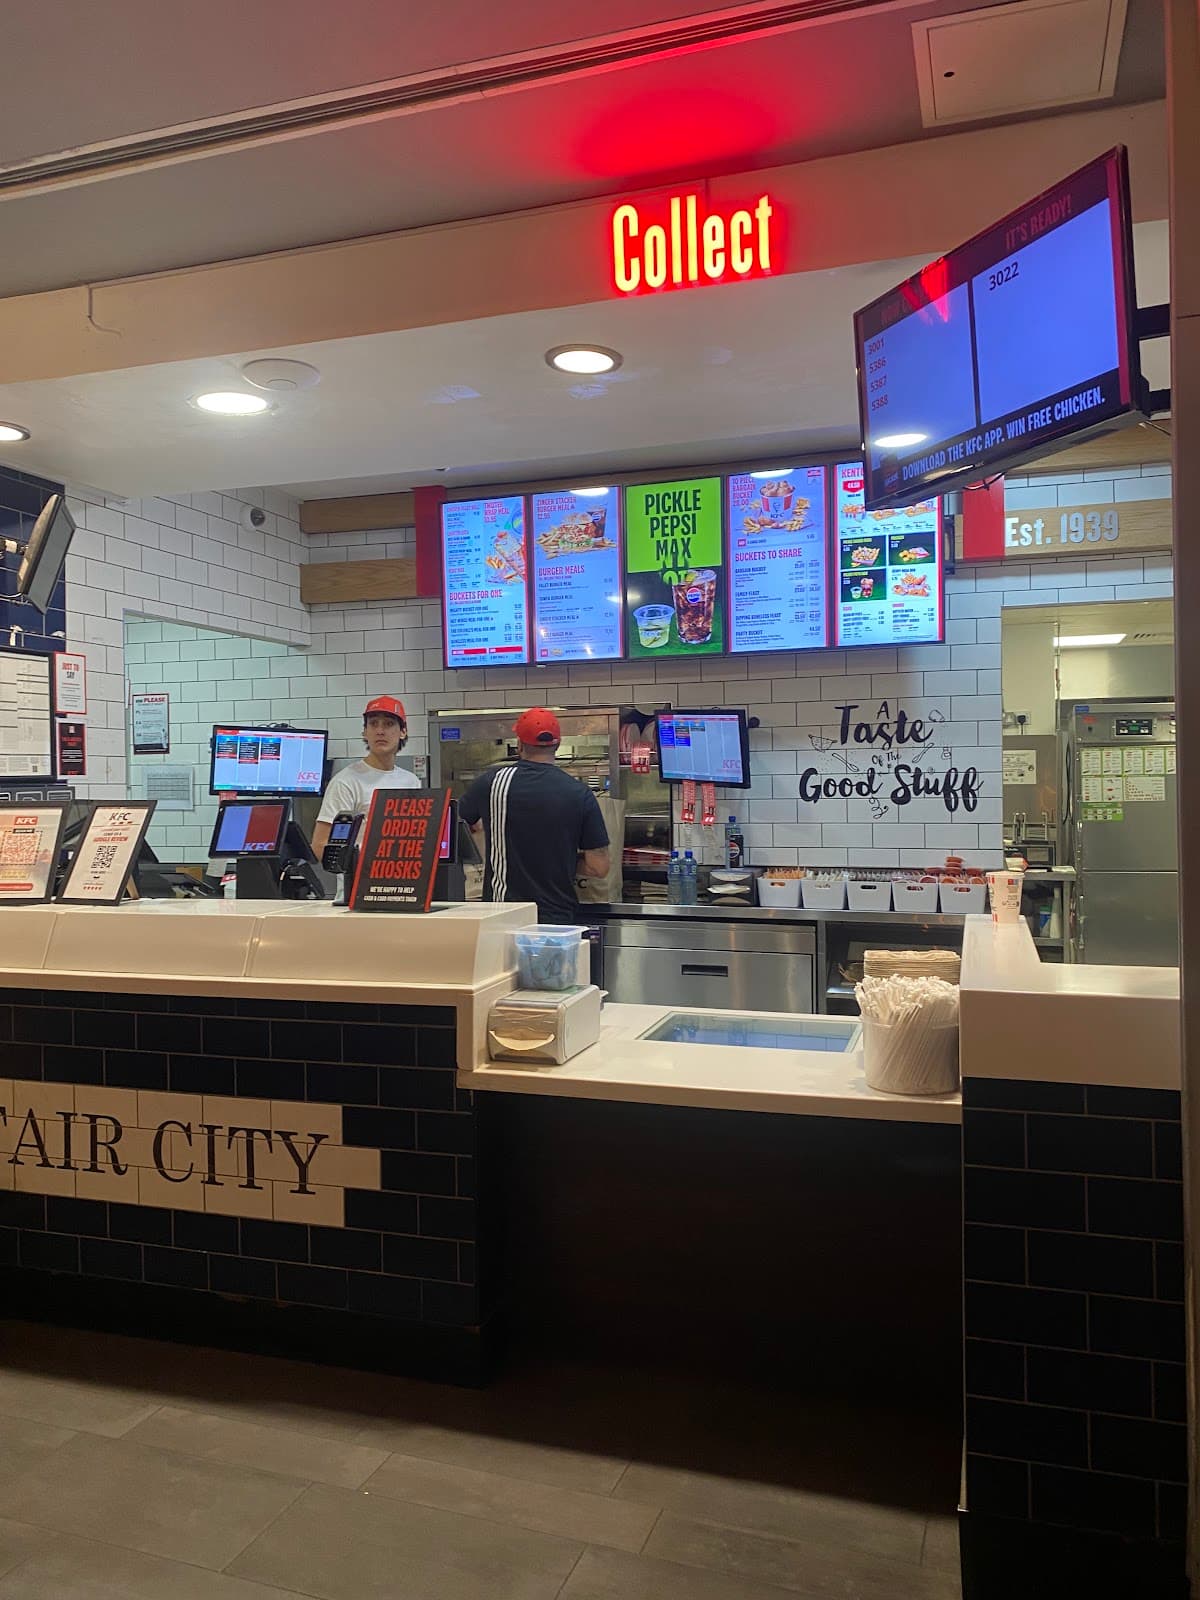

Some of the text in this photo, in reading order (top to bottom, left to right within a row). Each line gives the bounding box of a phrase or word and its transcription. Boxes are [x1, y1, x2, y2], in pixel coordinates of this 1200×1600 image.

[1006, 194, 1072, 249] IT'S READY!
[612, 194, 773, 292] Collect
[989, 262, 1019, 291] 3022
[902, 386, 1106, 480] DOWNLOAD THE KFC APP. WIN FREE CHICKEN.
[645, 489, 701, 516] PICKLE
[650, 513, 697, 539] PEPSI
[1004, 509, 1120, 547] Est. 1939
[656, 537, 692, 561] MAX
[735, 548, 802, 562] BUCKETS TO SHARE
[539, 565, 585, 576] BURGER MEALS
[449, 589, 503, 600] BUCKETS FOR ONE
[876, 701, 890, 720] A
[834, 704, 934, 751] Taste
[722, 759, 741, 769] KFC
[297, 772, 320, 781] KFC
[799, 767, 884, 804] Good
[890, 763, 985, 813] Stuff
[109, 812, 132, 821] KFC
[383, 798, 434, 817] PLEASE
[16, 817, 37, 825] KFC
[381, 818, 428, 837] ORDER
[244, 842, 275, 851] KFC
[375, 839, 425, 857] AT THE
[369, 860, 422, 879] KIOSKS
[0, 1106, 330, 1196] AIR CITY
